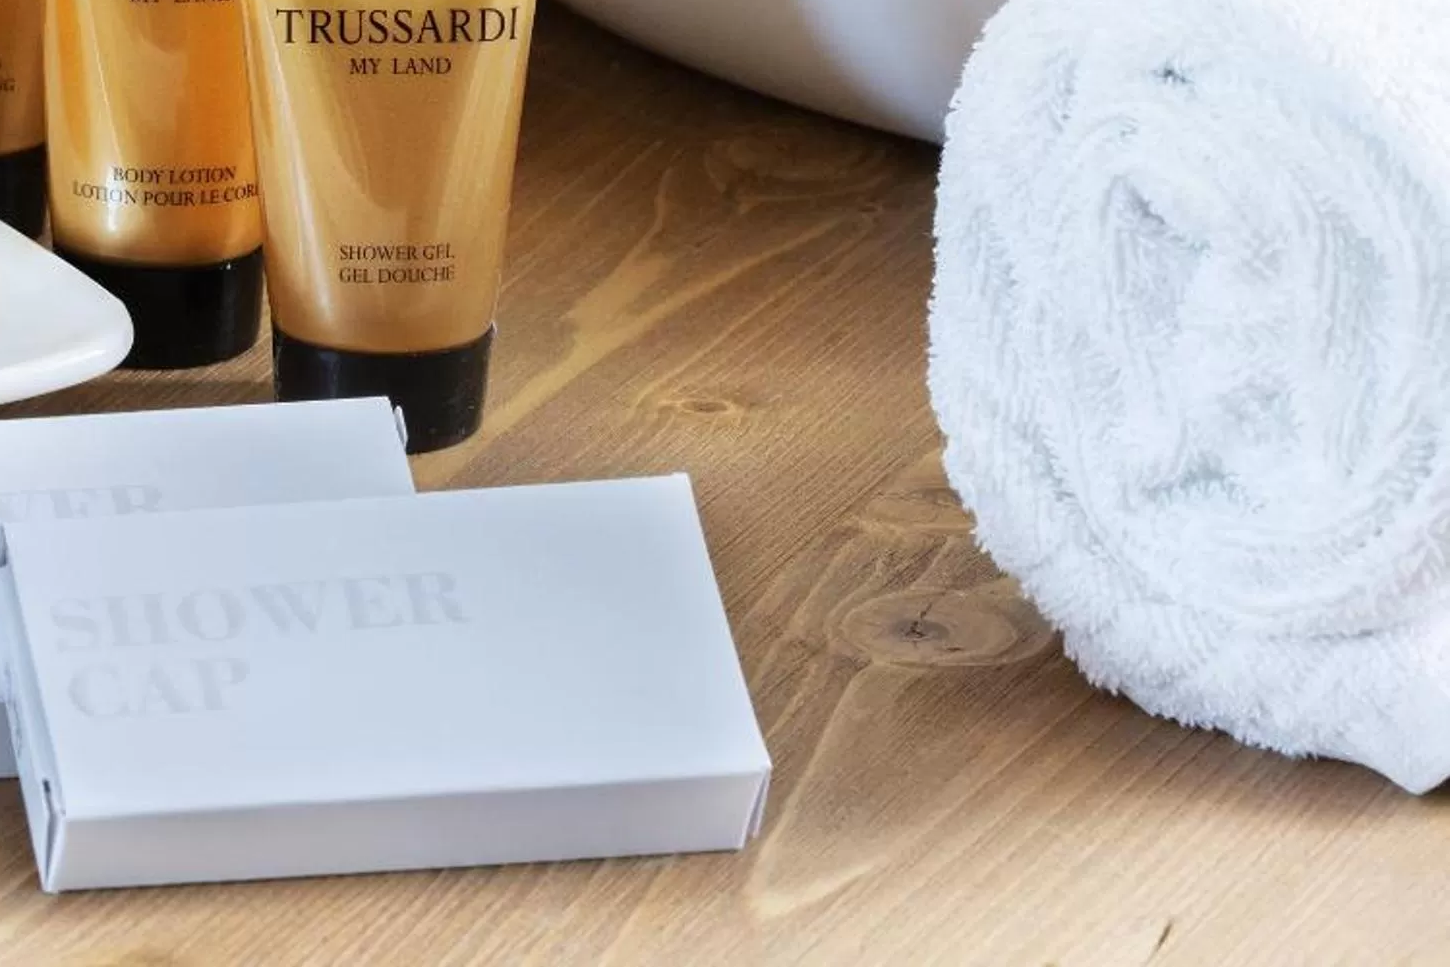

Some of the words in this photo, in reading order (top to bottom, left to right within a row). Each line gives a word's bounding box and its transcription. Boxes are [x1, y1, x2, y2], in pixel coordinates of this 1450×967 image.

[276, 5, 522, 45] TRUSSARDI
[349, 57, 382, 76] MY
[392, 56, 452, 76] LAND
[113, 165, 165, 184] BODY
[169, 165, 238, 184] LOTION
[72, 179, 138, 204] LOTION
[143, 189, 197, 207] POUR
[200, 189, 220, 205] LE
[223, 183, 260, 203] COR
[339, 244, 418, 261] SHOWER
[422, 242, 455, 260] GEL
[339, 267, 373, 284] GEL
[377, 265, 455, 284] DOUCHE
[49, 571, 471, 654] SHOWER
[67, 656, 251, 719] CAP
